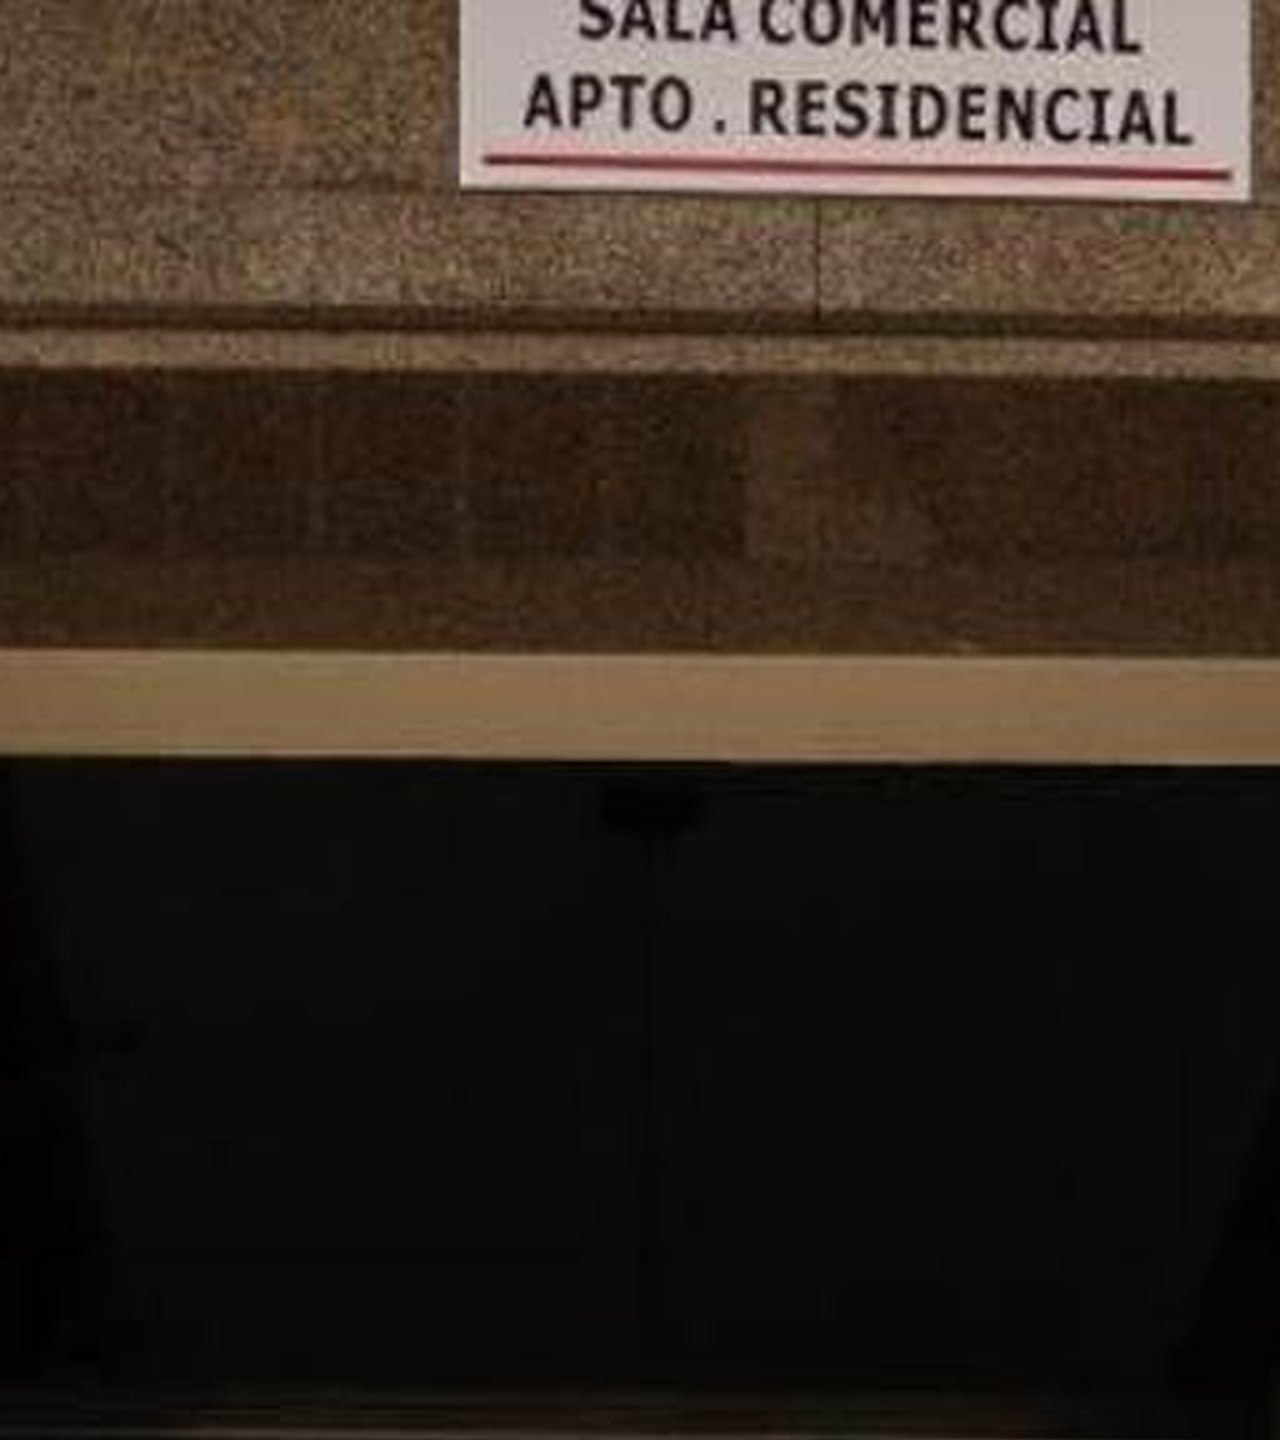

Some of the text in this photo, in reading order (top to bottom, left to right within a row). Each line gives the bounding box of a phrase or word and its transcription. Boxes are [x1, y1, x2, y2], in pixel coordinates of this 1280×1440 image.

[578, 0, 1143, 54] SALA COMERCIAL
[749, 78, 1194, 146] RESIDENCIAL
